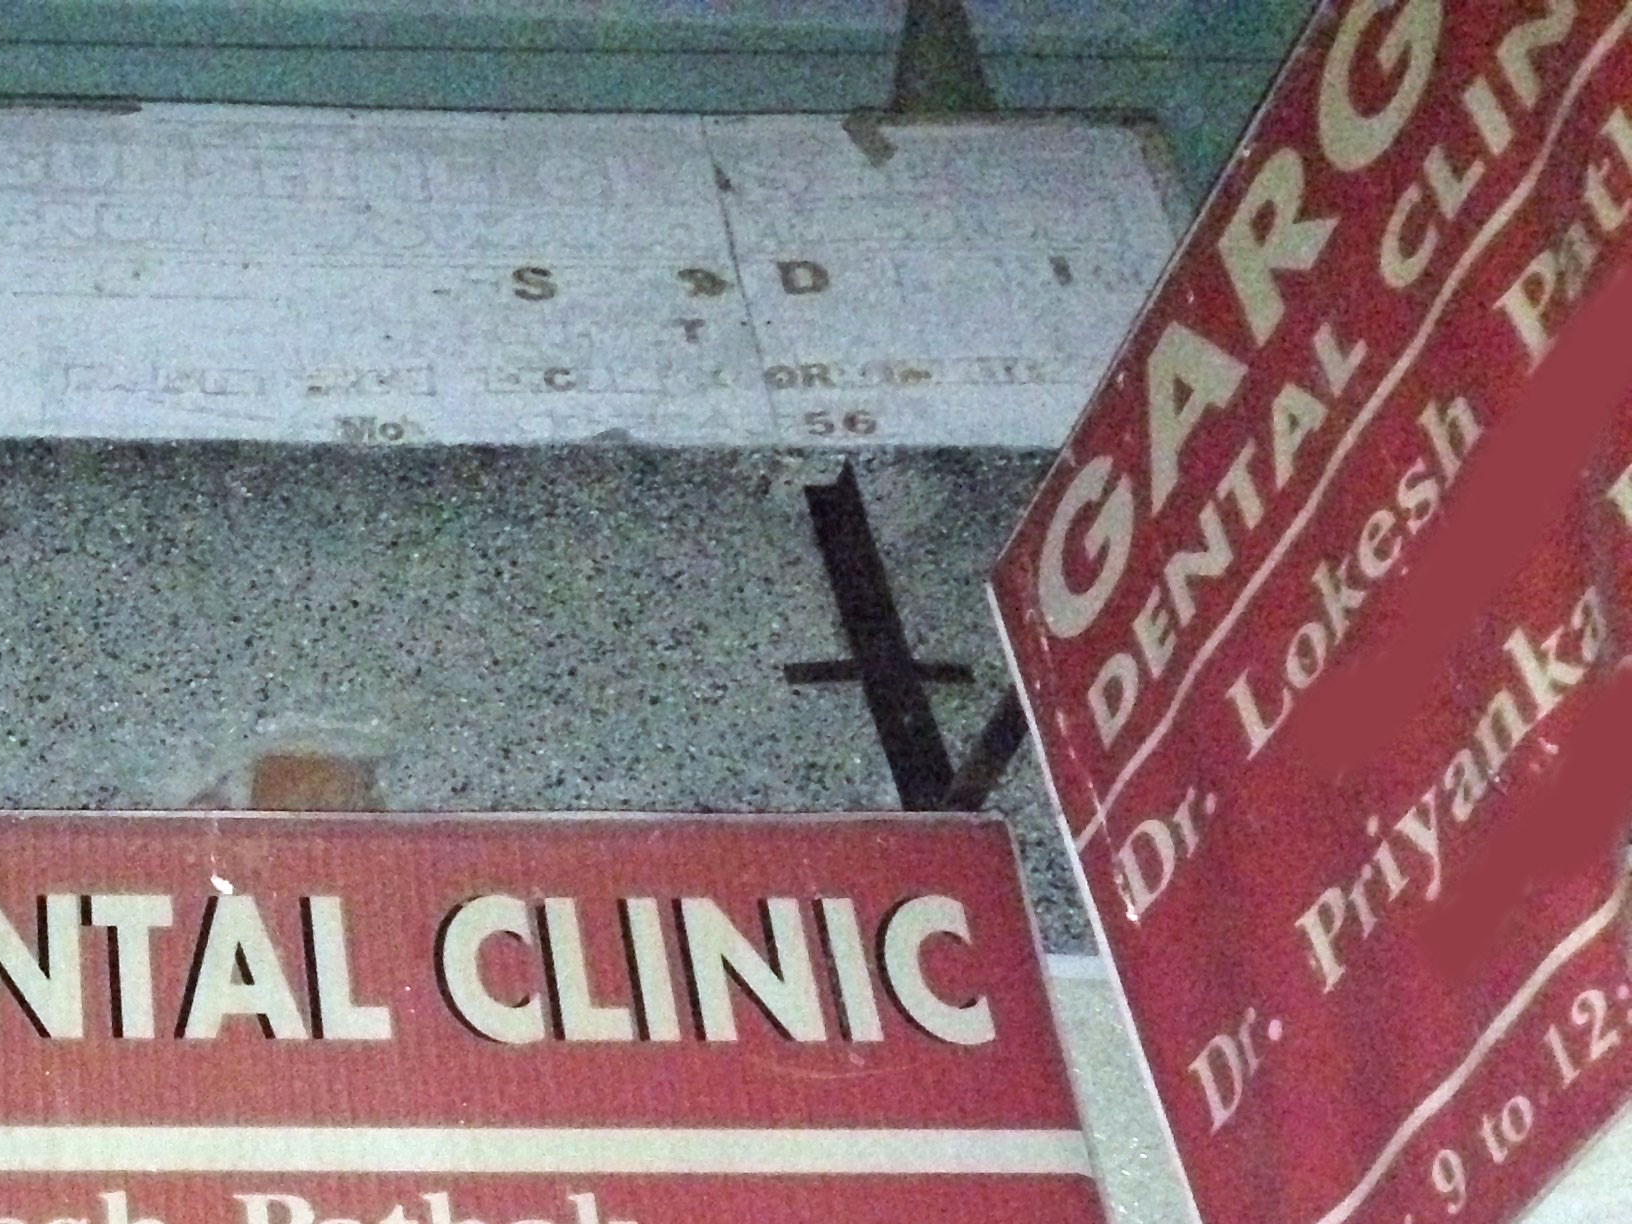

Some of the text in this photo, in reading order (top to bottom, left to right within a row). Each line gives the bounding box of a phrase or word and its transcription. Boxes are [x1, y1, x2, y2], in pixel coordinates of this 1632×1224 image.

[1086, 322, 1366, 747] DENTAL
[1117, 786, 1216, 921] Dr.
[1225, 396, 1484, 760] Lokesh
[433, 894, 996, 1045] CLINIC
[1187, 586, 1608, 1134] Dr. Priyanka
[1431, 1148, 1466, 1214] 9
[1479, 1095, 1534, 1165] to
